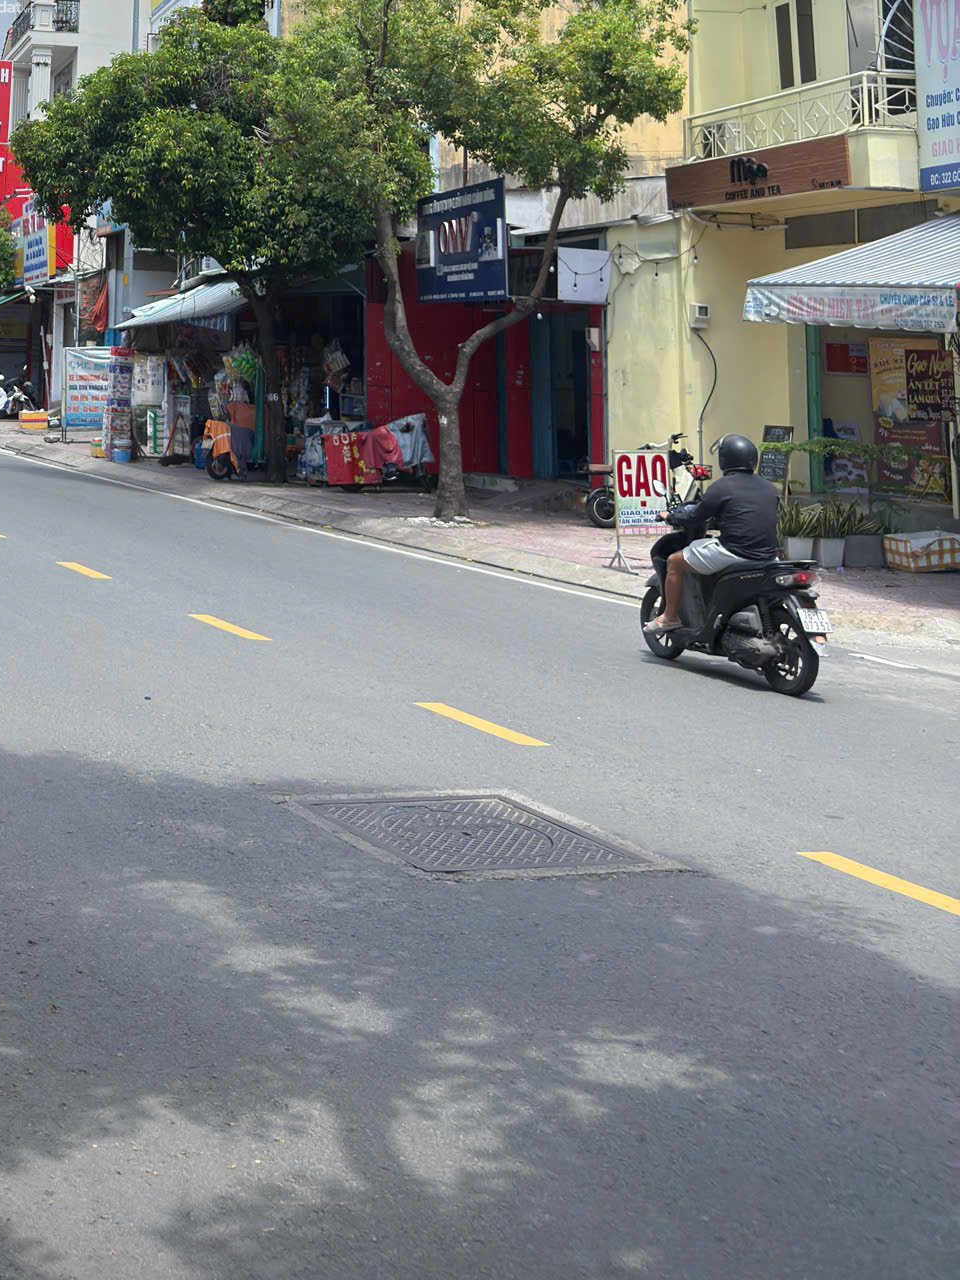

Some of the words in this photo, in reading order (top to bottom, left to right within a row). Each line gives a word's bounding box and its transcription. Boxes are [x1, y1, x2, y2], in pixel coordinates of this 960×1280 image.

[925, 90, 954, 108] Chuyên:
[927, 117, 940, 133] Gạo
[942, 112, 955, 128] Hữu
[932, 138, 954, 157] GIAO
[941, 171, 952, 184] 322
[725, 189, 749, 201] COFFEE
[750, 187, 766, 198] AND
[767, 184, 781, 195] TEA
[617, 454, 667, 507] GẠO
[643, 508, 662, 517] HÀN
